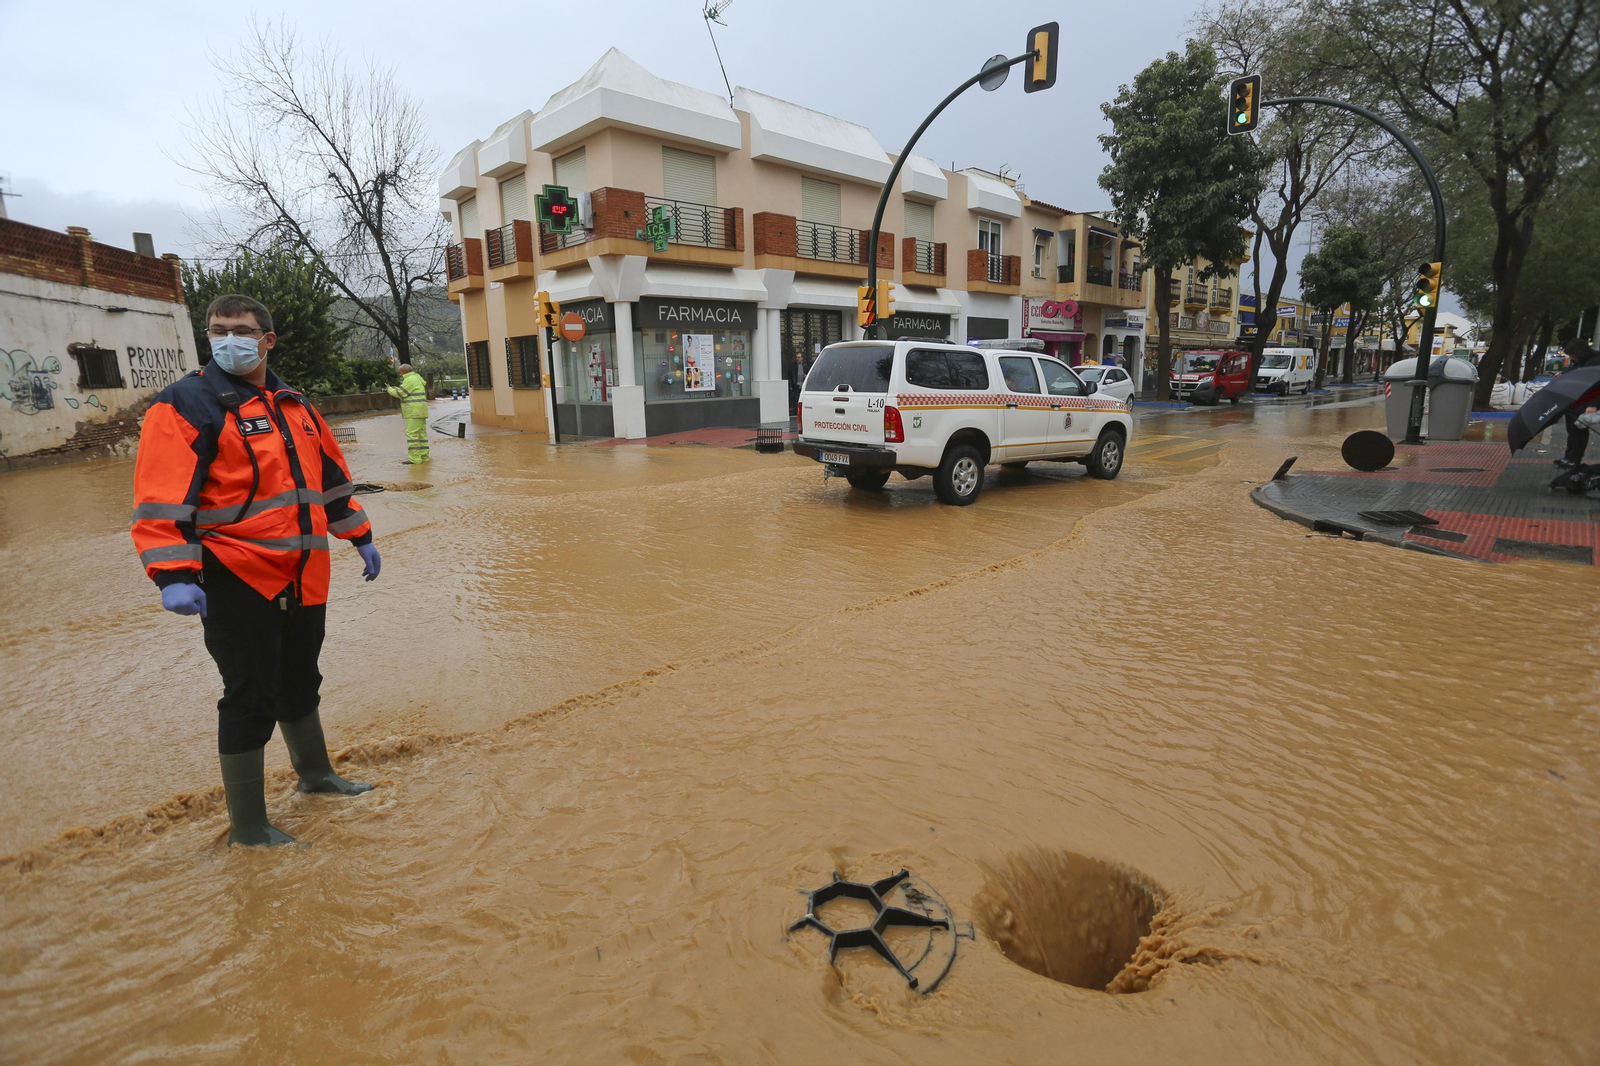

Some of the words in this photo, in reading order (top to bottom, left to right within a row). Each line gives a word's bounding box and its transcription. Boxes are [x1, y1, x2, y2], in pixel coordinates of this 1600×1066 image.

[658, 305, 743, 323] FARMACIA
[893, 317, 942, 331] FARMACIA
[127, 346, 187, 372] PROXIMO
[868, 398, 885, 409] L-10
[814, 420, 852, 431] PROTECCIÓN
[852, 423, 869, 433] CIVIL
[824, 452, 838, 462] 0049
[838, 455, 849, 463] FVX
